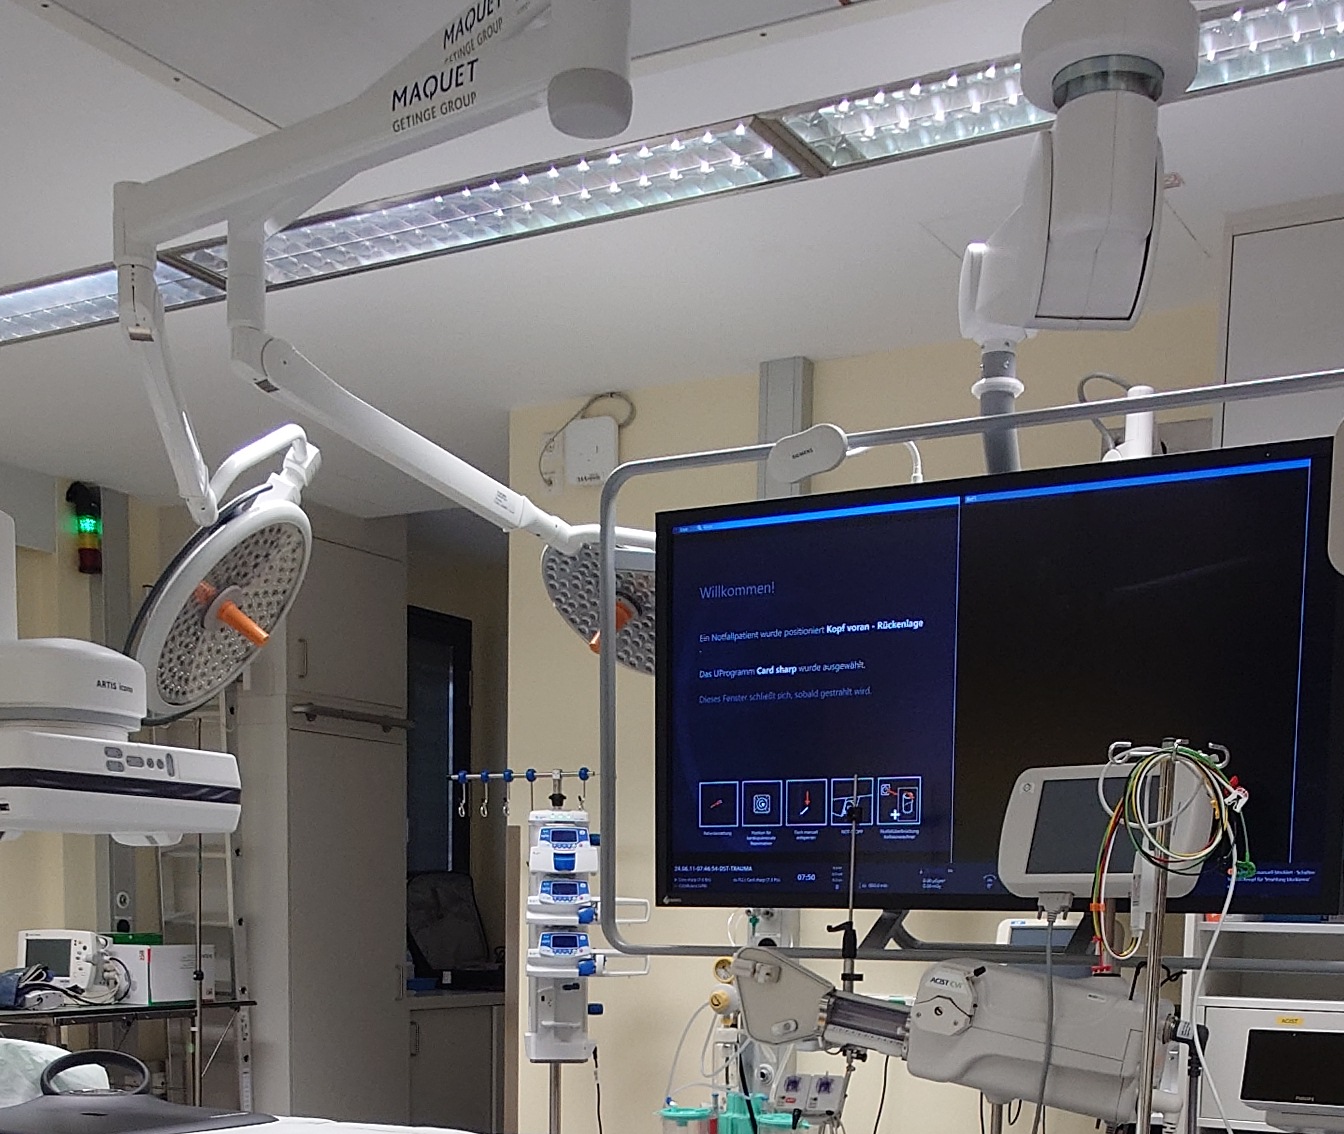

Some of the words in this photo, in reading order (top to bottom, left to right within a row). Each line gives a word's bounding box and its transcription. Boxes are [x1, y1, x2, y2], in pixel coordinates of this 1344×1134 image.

[477, 17, 503, 46] GROUP
[391, 58, 479, 112] MAQUET
[392, 106, 437, 133] GETINGE
[440, 91, 477, 115] GROUP
[699, 581, 775, 599] Willkommen!
[699, 633, 710, 643] Ein
[711, 630, 759, 643] Notfallpatient
[760, 628, 782, 639] wurde
[784, 625, 825, 638] positioniert
[826, 622, 845, 634] Kopf
[847, 622, 870, 632] voran
[877, 618, 924, 630] Rückenlage
[699, 669, 712, 678] Das
[756, 665, 774, 676] Card
[775, 664, 797, 676] sharp
[798, 663, 821, 673] wurde
[96, 680, 117, 690] ARTIS
[930, 977, 949, 986] ACIST
